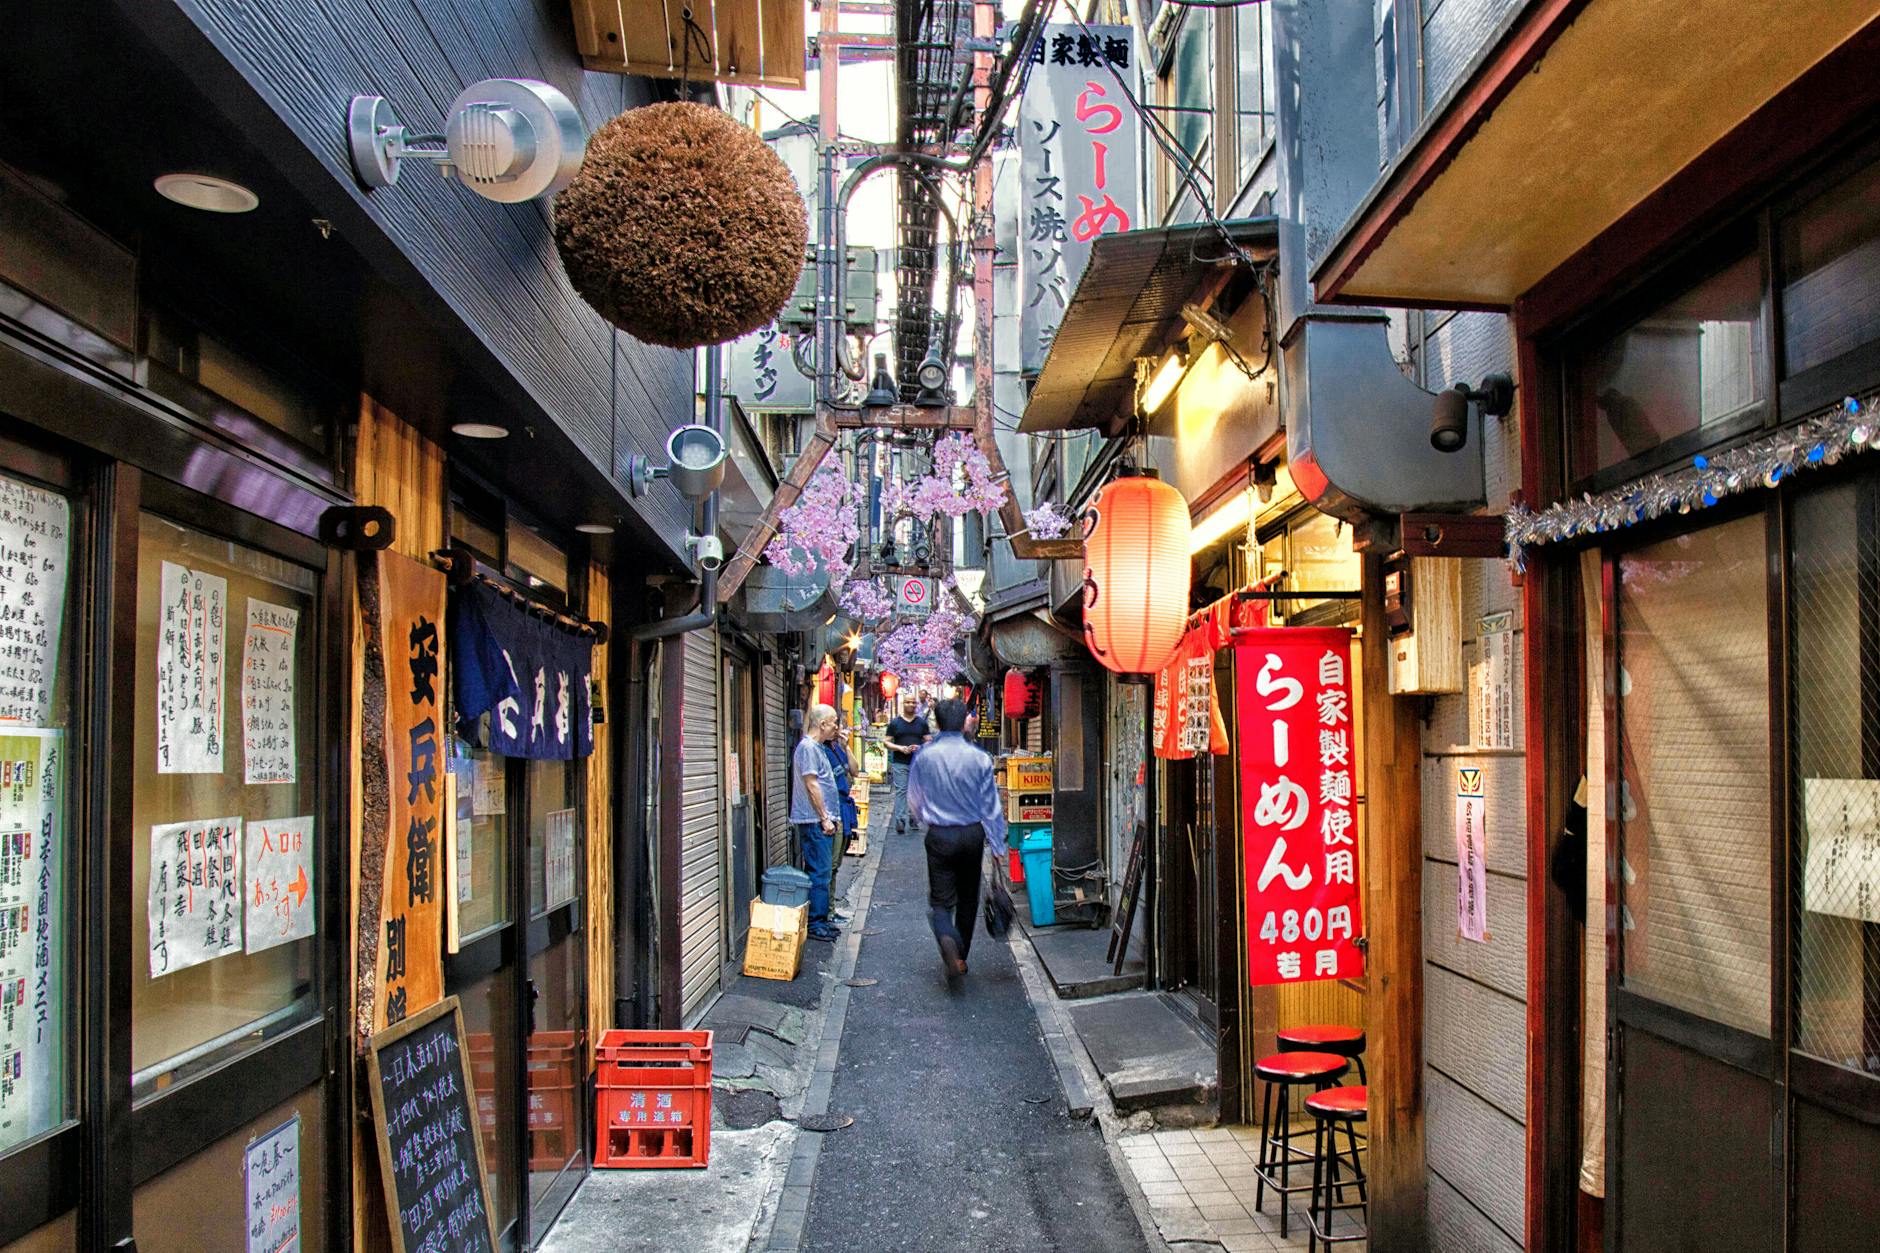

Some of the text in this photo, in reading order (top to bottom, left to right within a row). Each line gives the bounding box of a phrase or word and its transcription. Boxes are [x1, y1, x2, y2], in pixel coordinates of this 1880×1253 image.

[1031, 32, 1129, 69] 自家製麺
[1029, 119, 1067, 309] ソース焼ソバ
[405, 615, 439, 908] 安兵衛
[1024, 775, 1051, 784] KIRIN
[1252, 653, 1313, 893] らーめん
[1316, 650, 1354, 887] 自家製麺使用
[258, 826, 303, 865] 入口は
[1259, 904, 1352, 945] 480円
[1276, 949, 1338, 979] 若月
[630, 1092, 673, 1109] 清酒
